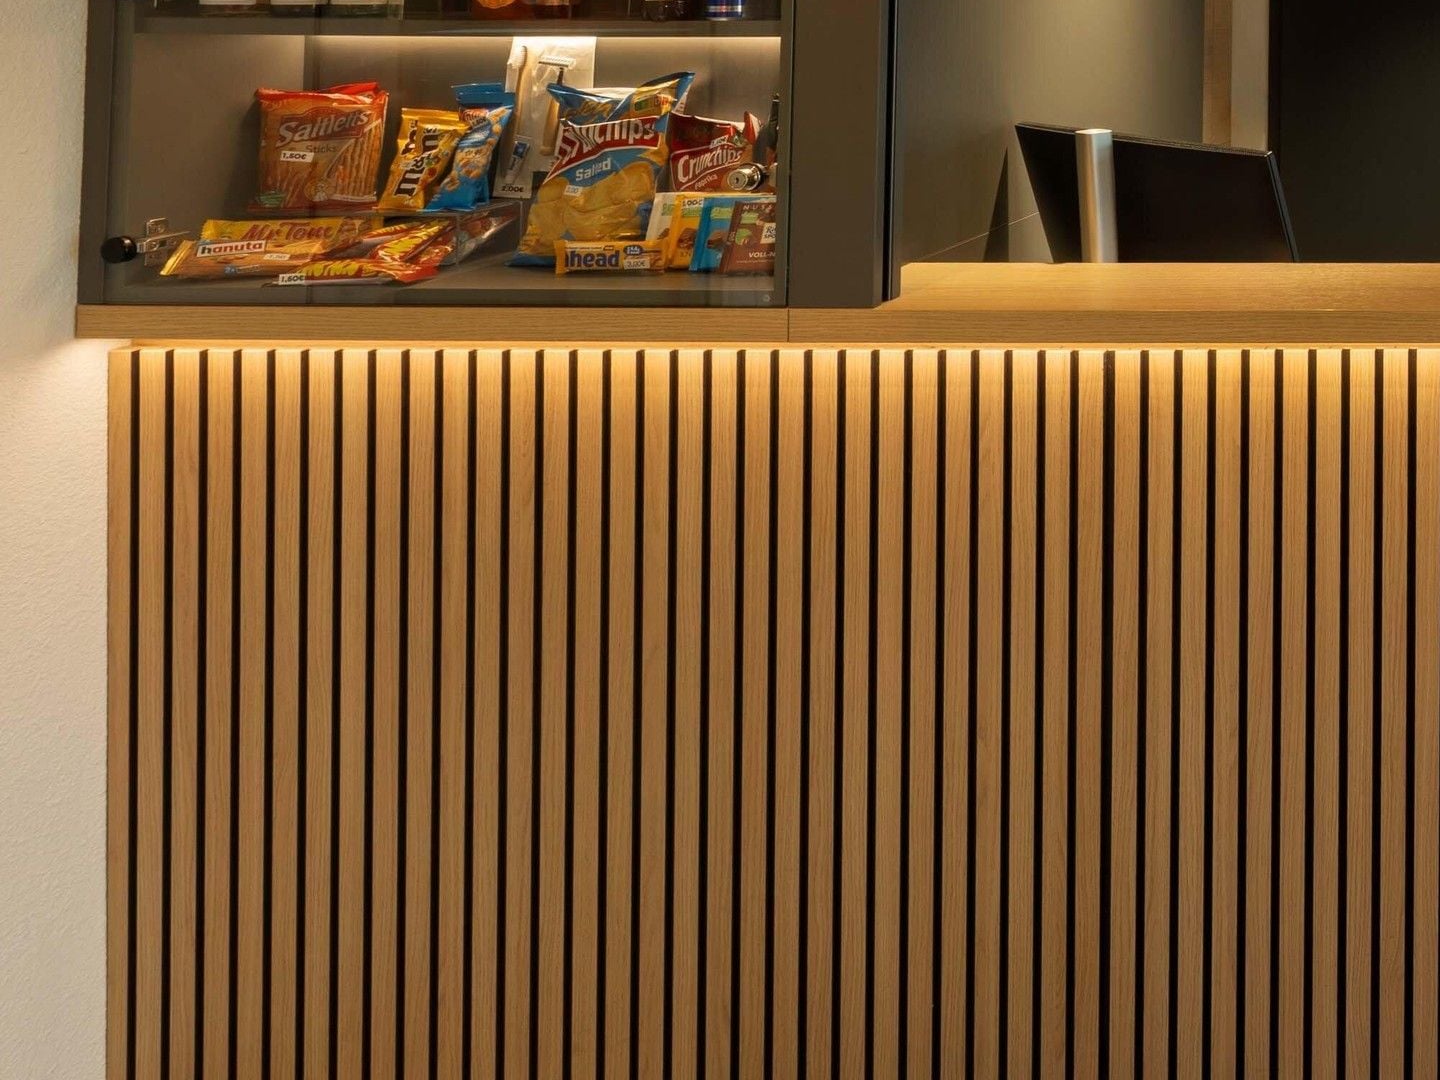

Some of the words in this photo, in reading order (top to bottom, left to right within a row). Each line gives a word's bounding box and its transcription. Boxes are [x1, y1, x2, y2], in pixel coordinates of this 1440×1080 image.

[677, 145, 744, 184] Crunchips
[200, 241, 263, 256] hanuta
[564, 249, 620, 268] head
